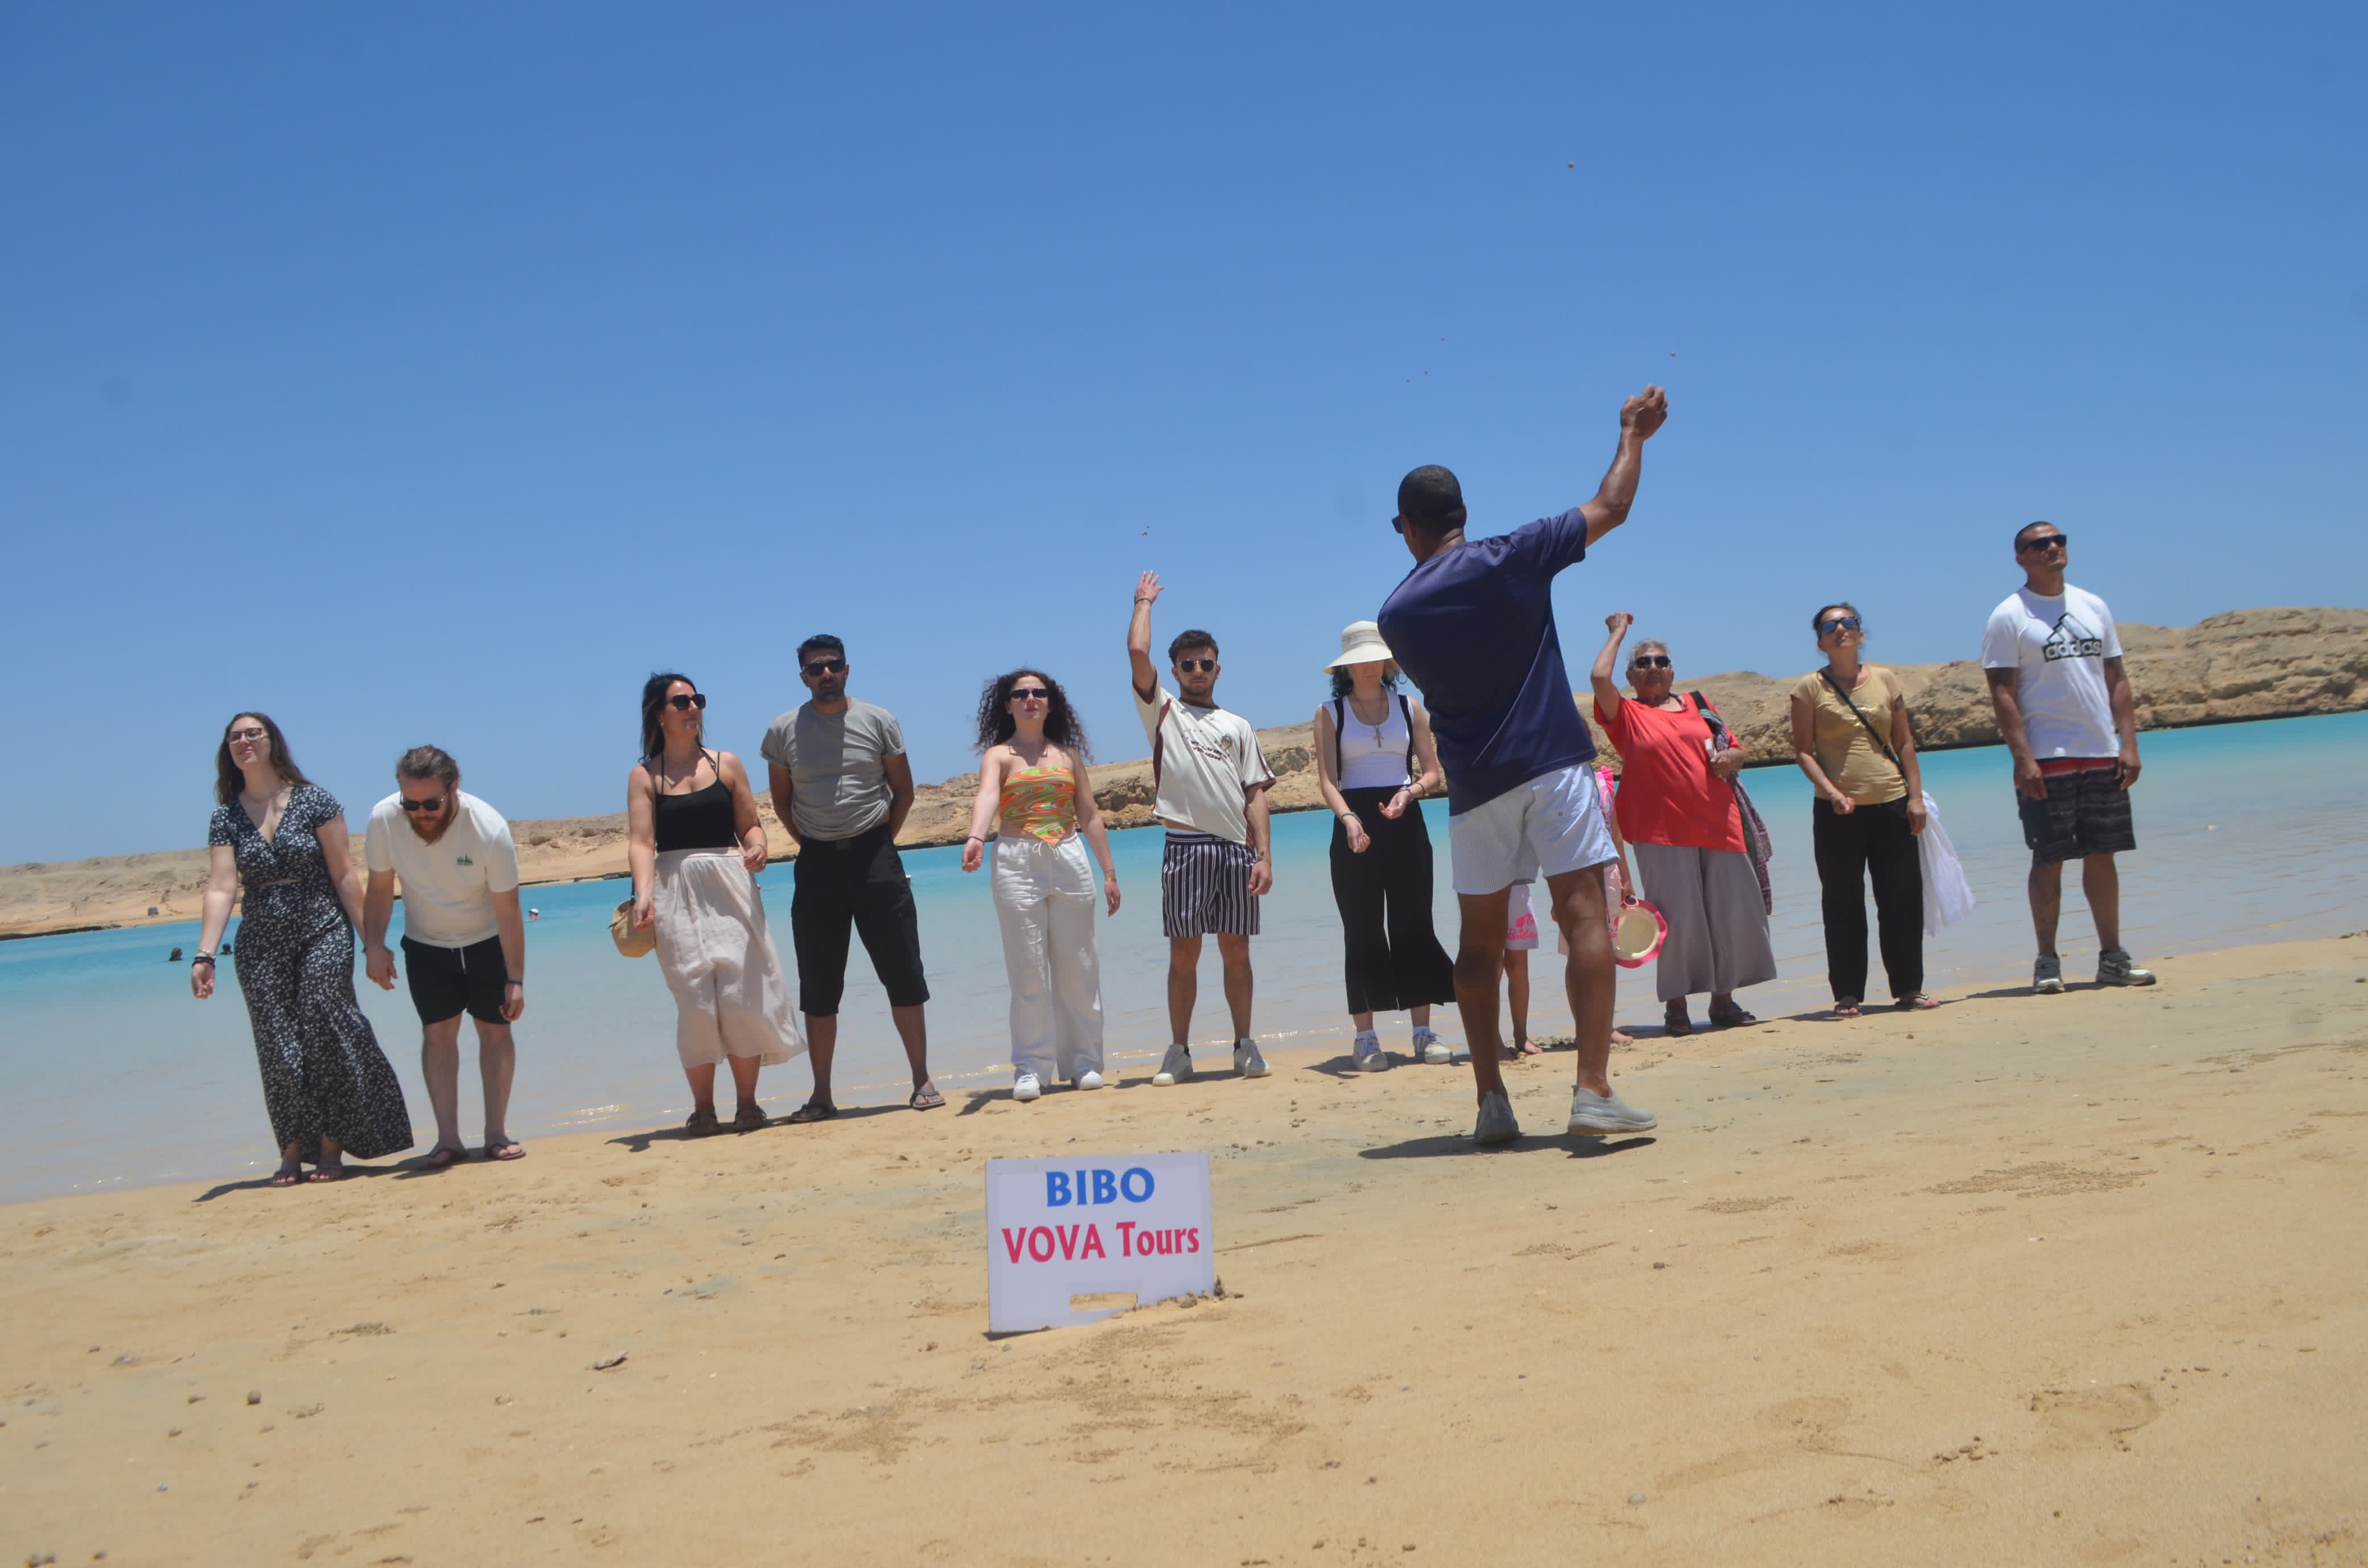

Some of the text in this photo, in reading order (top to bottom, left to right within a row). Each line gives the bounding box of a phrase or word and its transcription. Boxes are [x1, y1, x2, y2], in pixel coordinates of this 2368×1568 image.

[1046, 1167, 1154, 1207] BIBO
[1001, 1221, 1200, 1264] VOVA Tours
